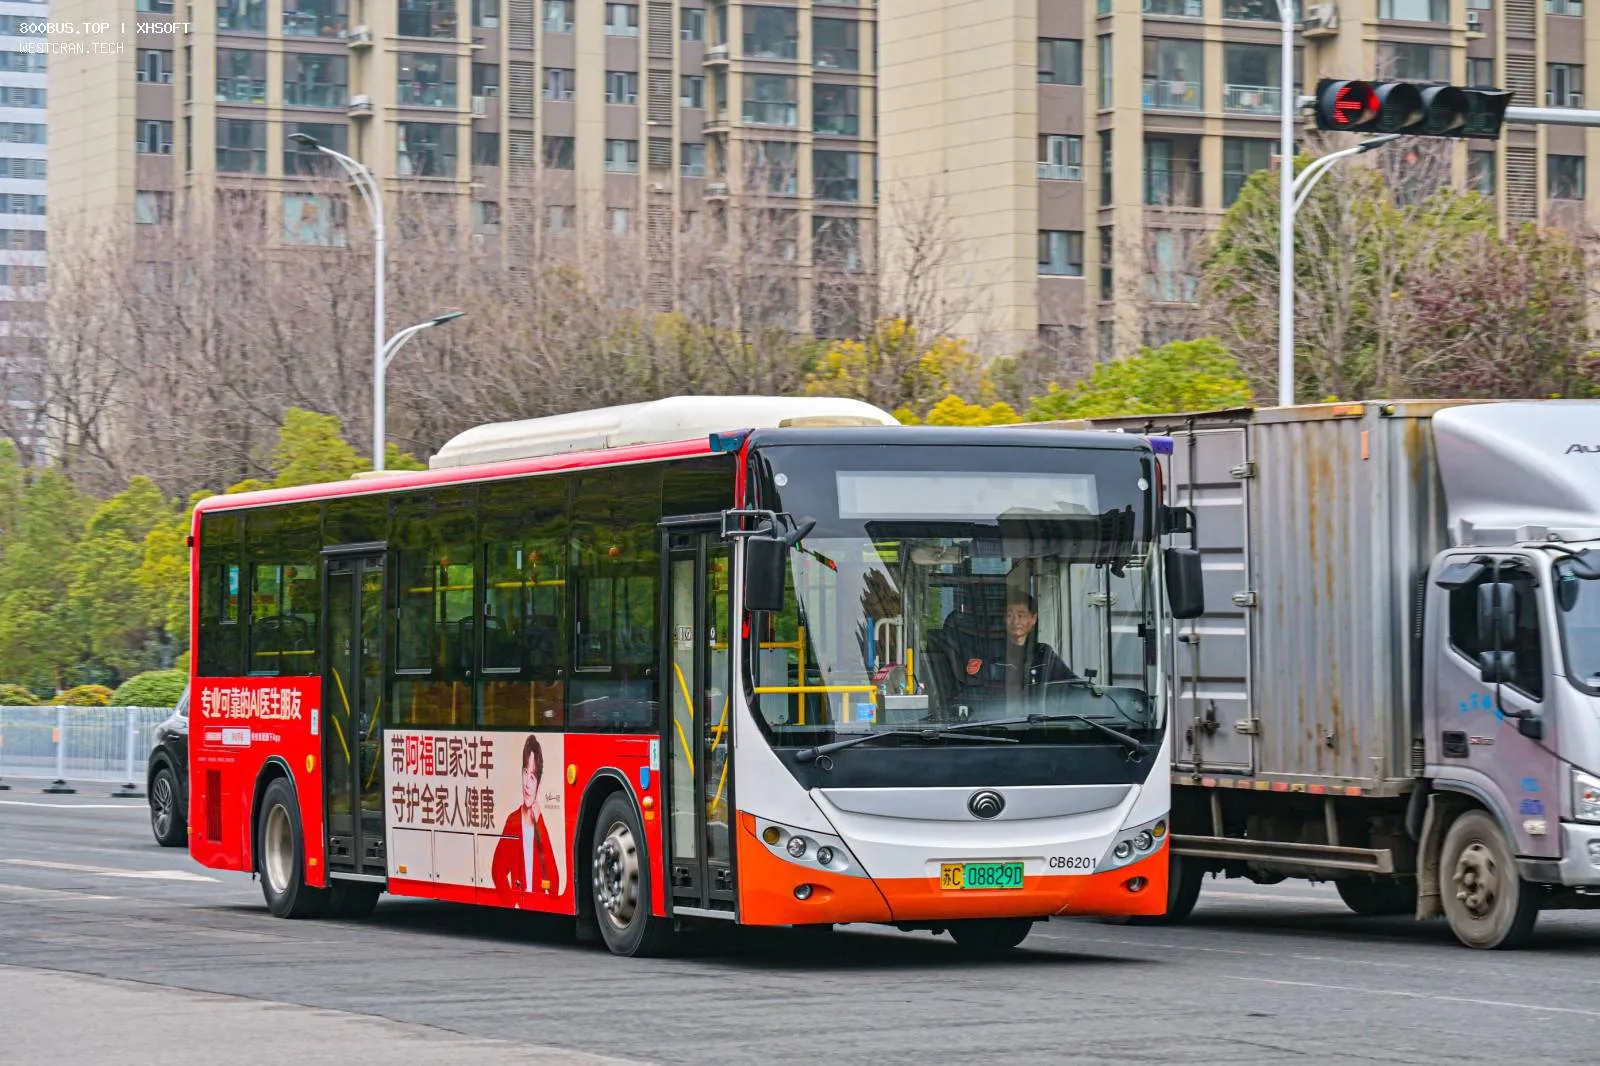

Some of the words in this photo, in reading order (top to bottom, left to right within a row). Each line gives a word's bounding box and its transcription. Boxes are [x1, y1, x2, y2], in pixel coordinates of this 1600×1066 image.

[201, 687, 302, 720] 专业可靠的AI医生朋友
[391, 734, 494, 779] 带阿福回家过年
[392, 781, 495, 829] 守护全家人健康
[1049, 856, 1096, 869] CB6201
